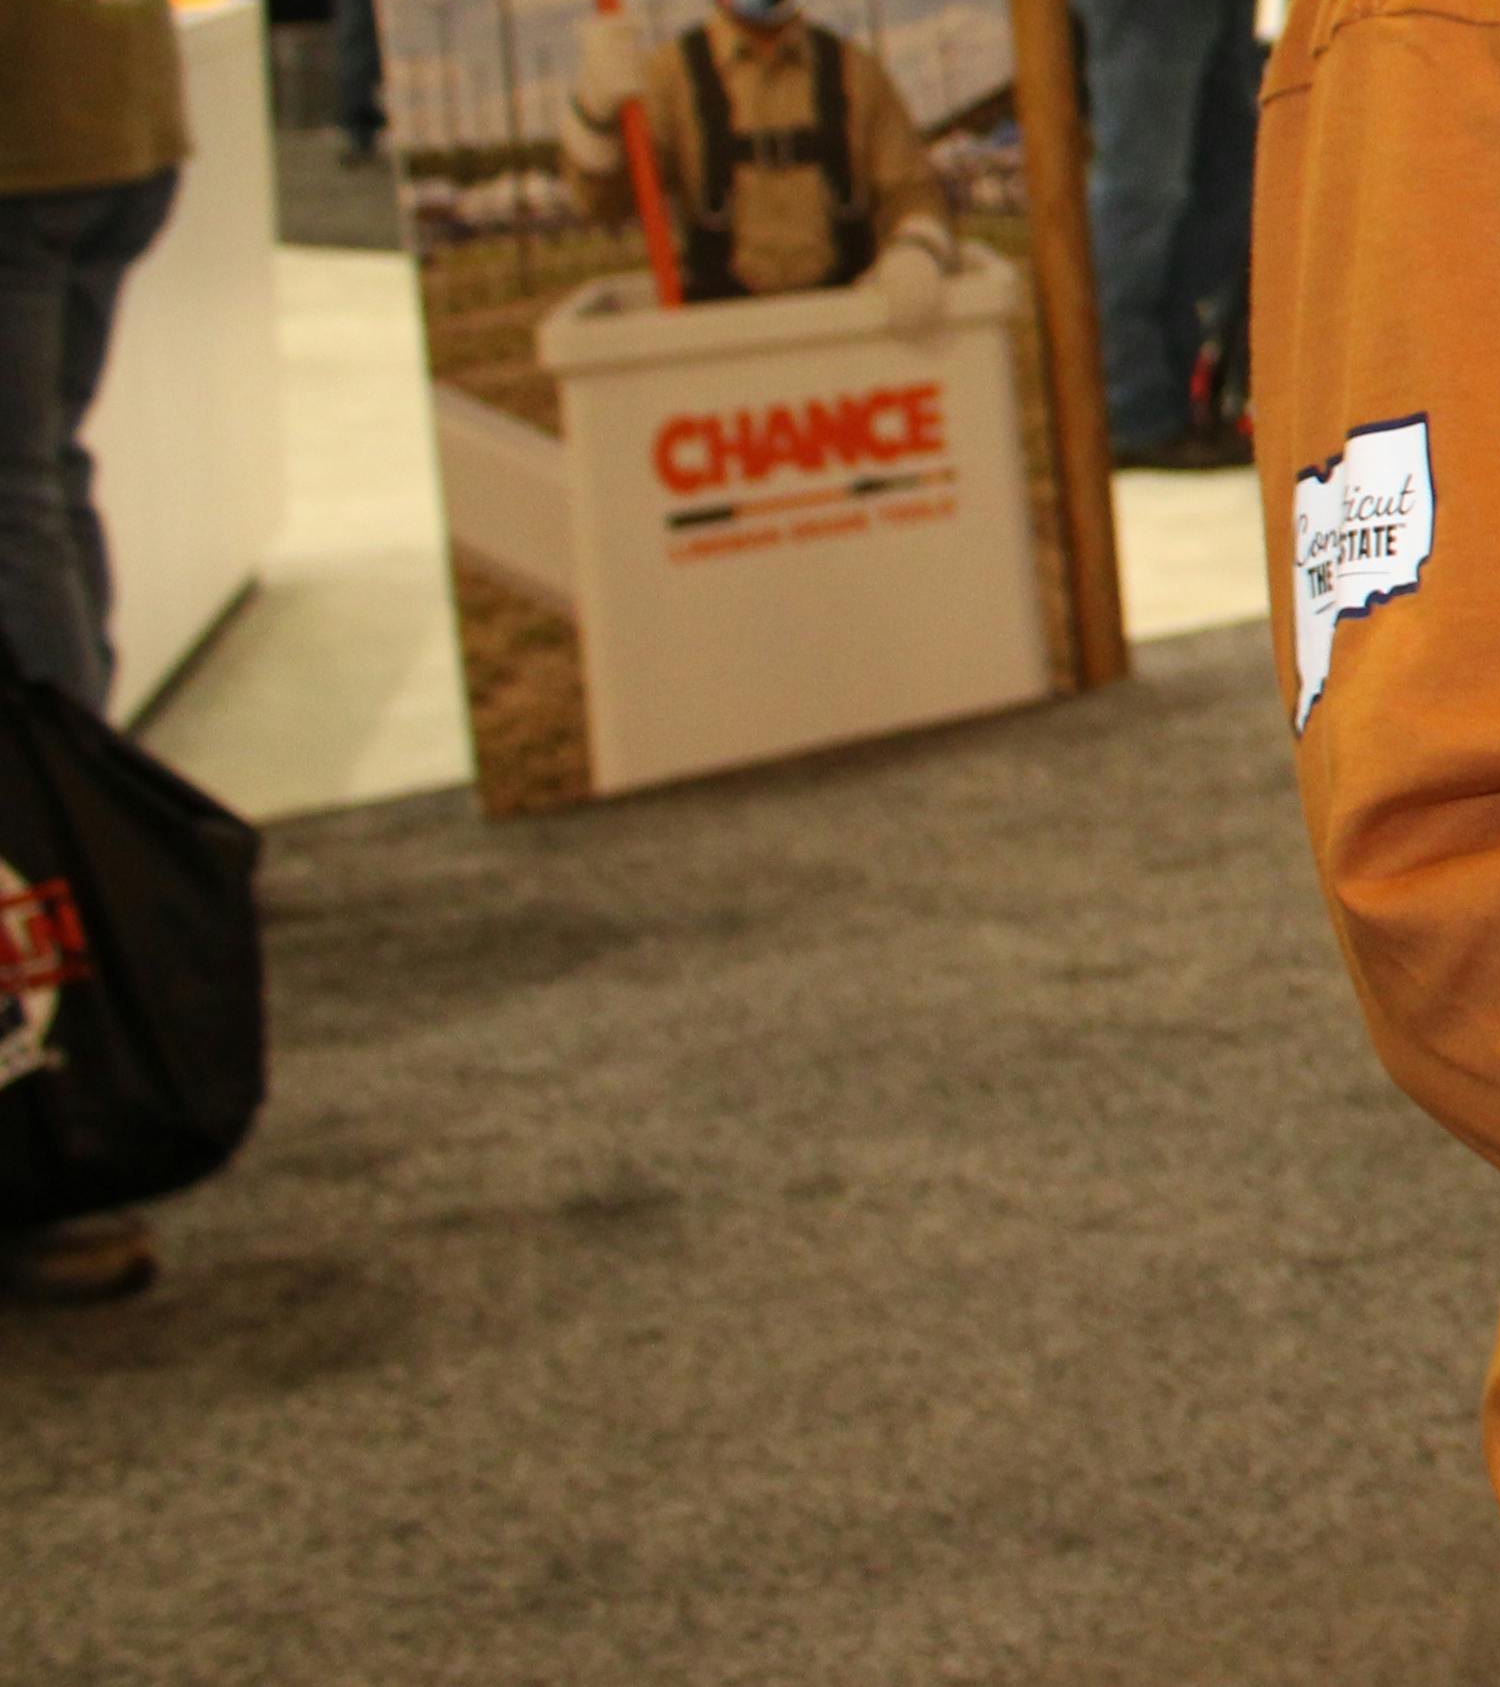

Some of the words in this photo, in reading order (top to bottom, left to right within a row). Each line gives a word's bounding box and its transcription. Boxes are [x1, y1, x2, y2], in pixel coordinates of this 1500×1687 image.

[652, 379, 946, 495] CHANCE
[1308, 559, 1334, 600] THE
[1337, 523, 1399, 564] STATE
